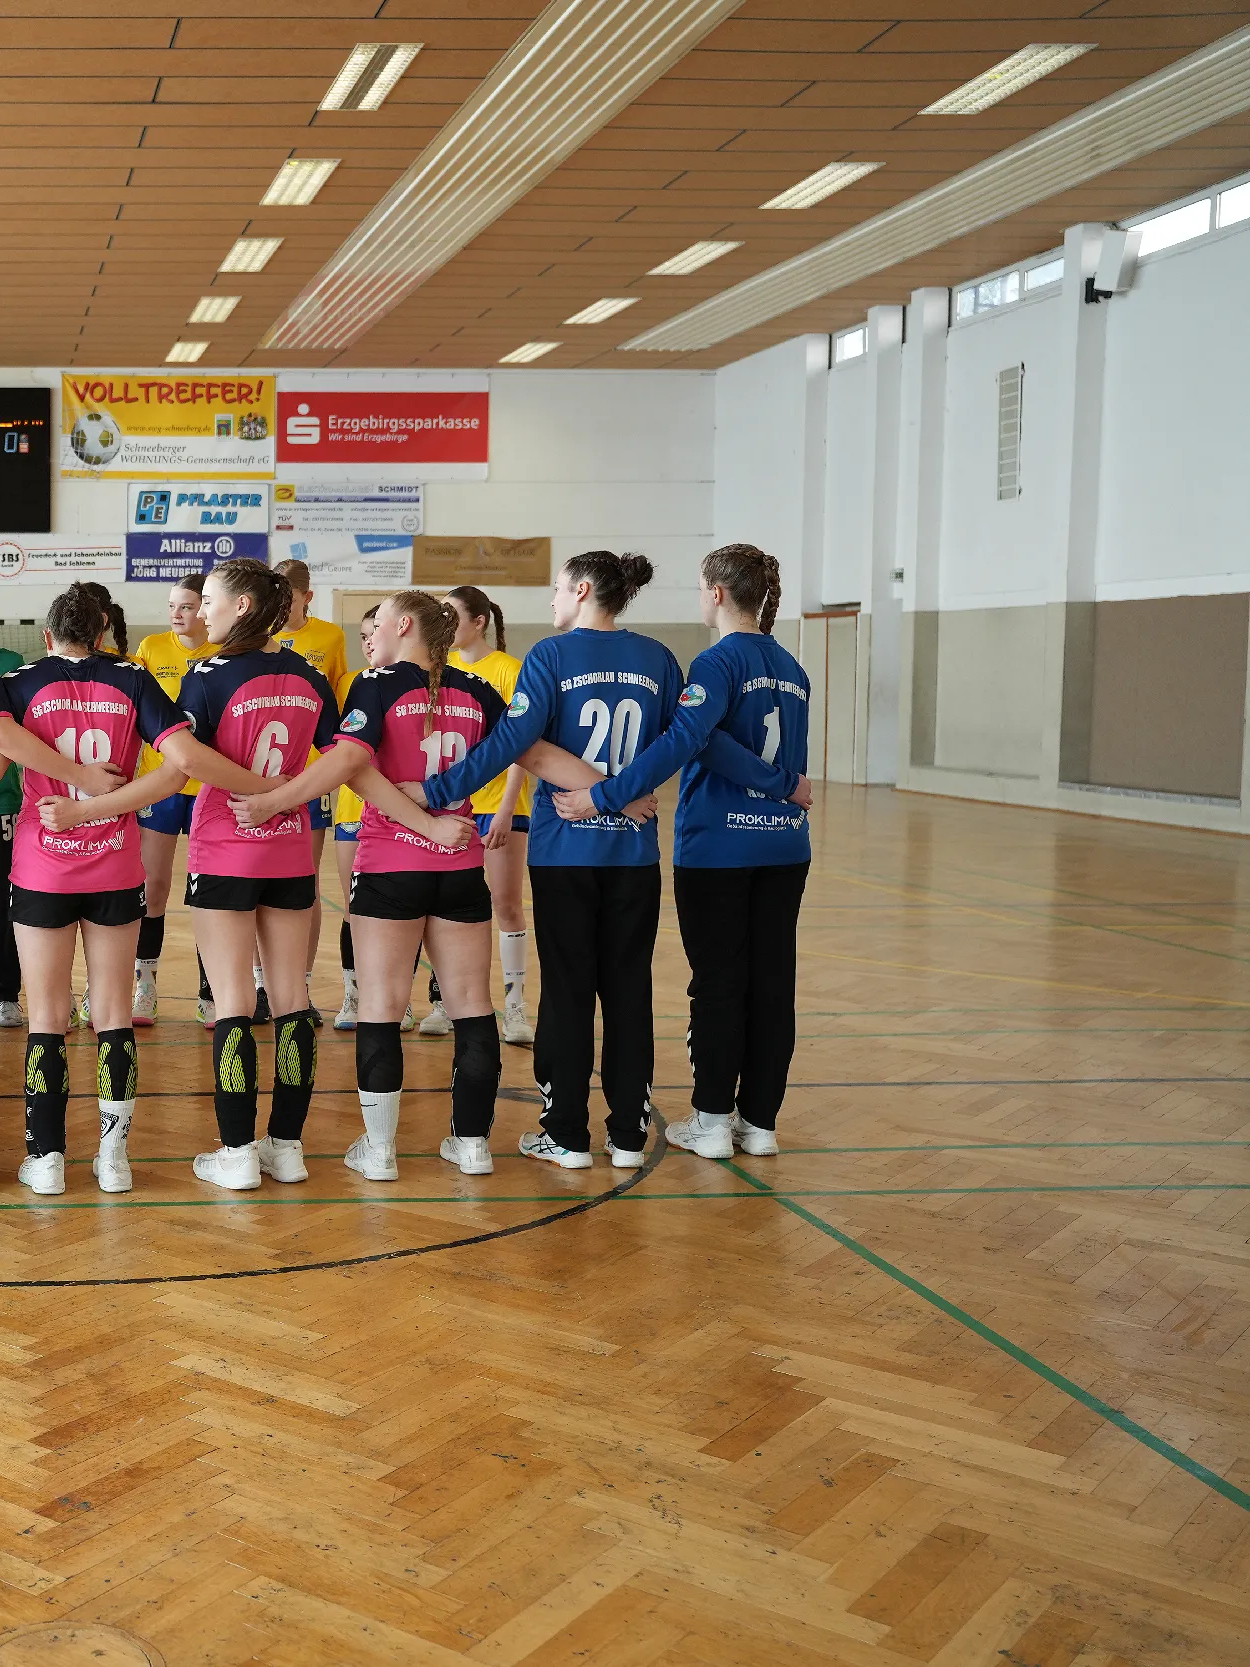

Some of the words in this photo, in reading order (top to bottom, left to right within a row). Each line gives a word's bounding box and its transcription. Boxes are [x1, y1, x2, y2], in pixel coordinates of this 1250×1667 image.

[73, 380, 264, 405] VOLLTREFFER!
[328, 414, 480, 433] Erzgebirgssparkasse
[328, 433, 342, 441] Wir
[344, 433, 362, 441] sind
[363, 433, 409, 443] Erzgebirge
[124, 443, 187, 455] Schneeberger
[121, 455, 255, 466] WOHNUNGS-Genossenschaft
[257, 456, 270, 465] eG
[378, 486, 419, 494] SCHMIDT
[176, 493, 263, 507] PFLASTER
[200, 511, 238, 525] BAU
[160, 539, 212, 553] Allianz
[132, 558, 203, 566] GENERALVERTRETUNG
[132, 566, 157, 578] JÖRG
[560, 678, 572, 692] SG
[572, 671, 615, 688] ZSCHORLAU
[617, 672, 659, 695] SCHNEEBERG
[31, 706, 42, 718] SG
[231, 703, 243, 718] SG
[395, 705, 407, 718] SG
[579, 698, 642, 776] 20
[763, 706, 781, 765] 1
[251, 720, 288, 778] 6
[573, 814, 631, 826] ROKLIMA
[726, 812, 791, 826] PROKLIMA
[43, 836, 109, 851] PROKLIMA
